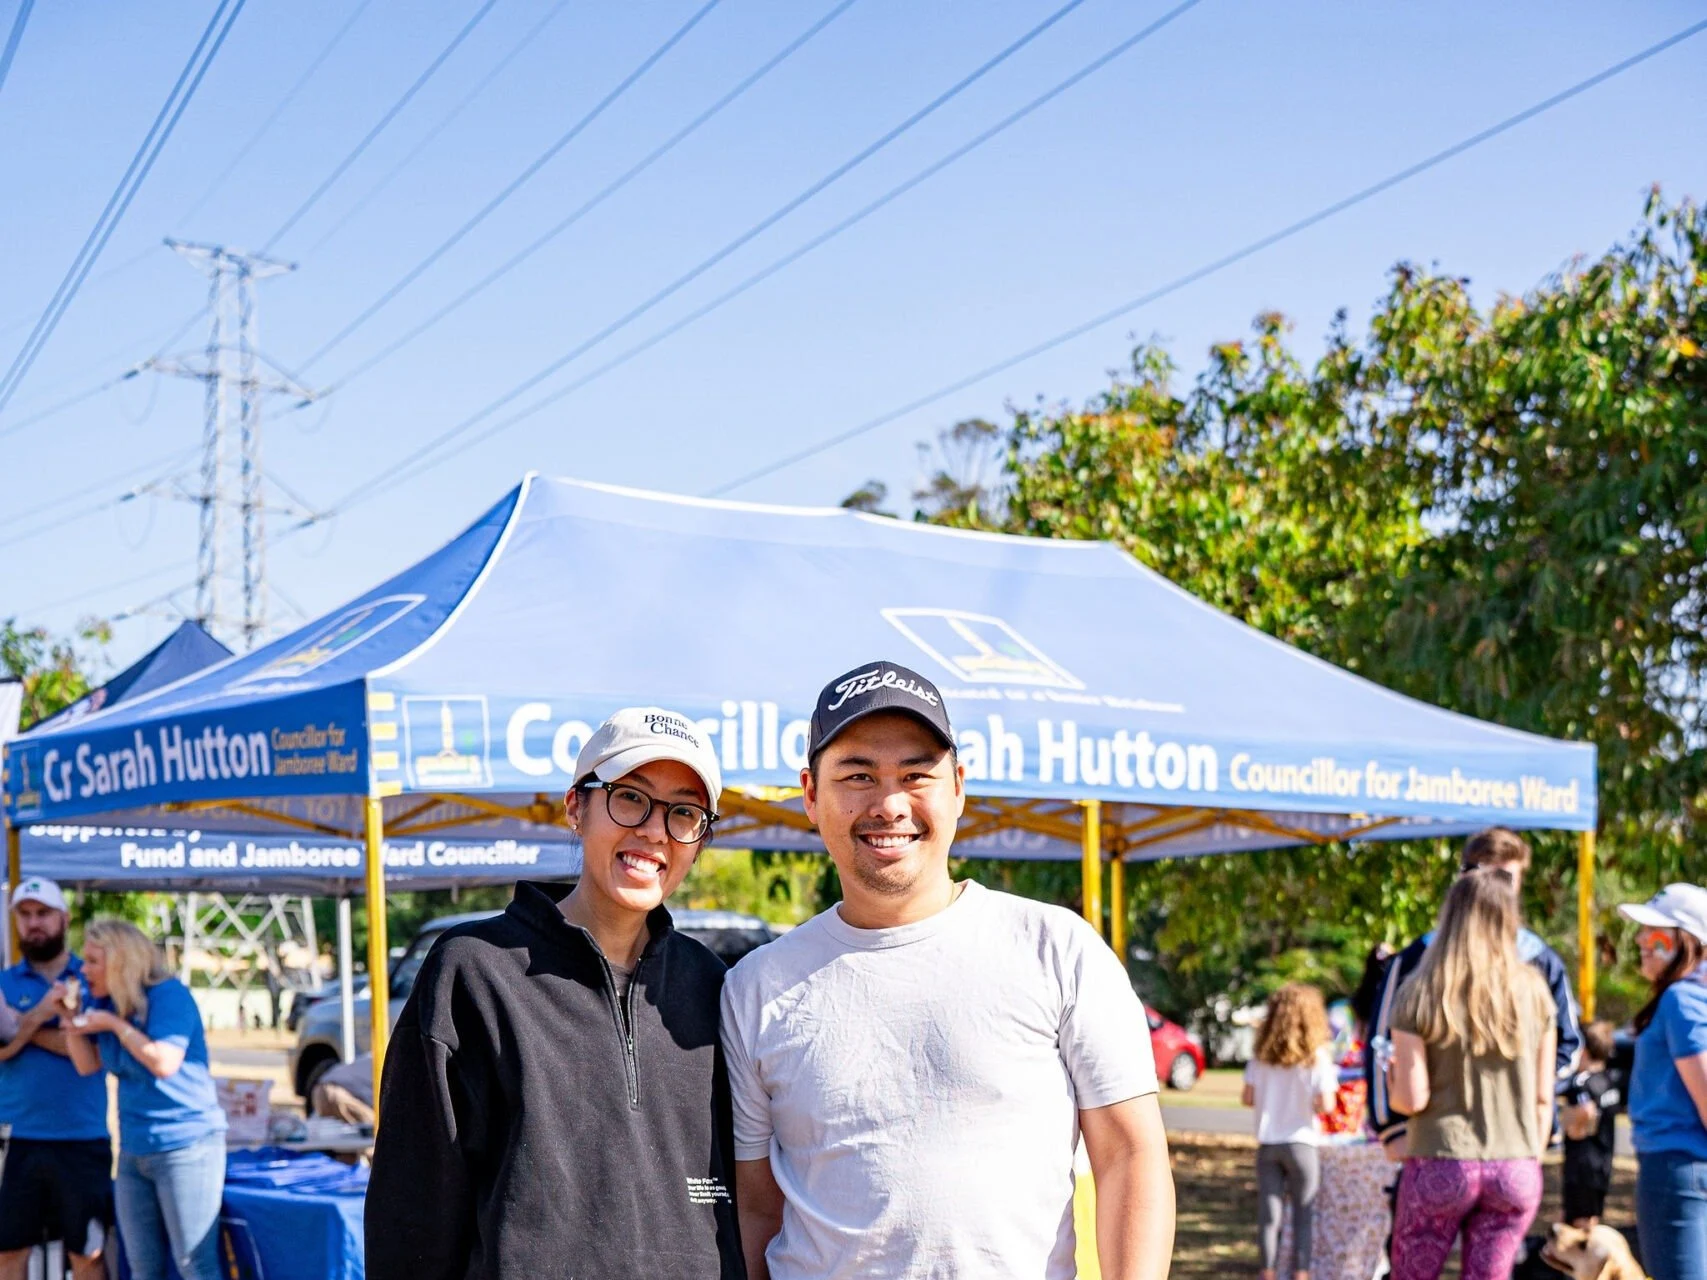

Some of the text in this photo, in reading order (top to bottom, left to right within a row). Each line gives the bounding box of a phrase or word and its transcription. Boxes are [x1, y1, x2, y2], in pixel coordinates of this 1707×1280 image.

[828, 669, 939, 711] Titleist
[644, 714, 688, 730] Bonne
[650, 722, 699, 749] Chance
[43, 724, 271, 801] Cr Sarah Hutton
[1037, 719, 1218, 792] Hutton
[1230, 753, 1362, 797] Councillor
[1365, 760, 1401, 800] for
[1404, 767, 1518, 809] Jamboree
[1519, 776, 1580, 813] Ward
[120, 841, 186, 868] Fund
[189, 841, 237, 868] and
[241, 841, 361, 868] Jamboree
[428, 840, 541, 866] Councillor
